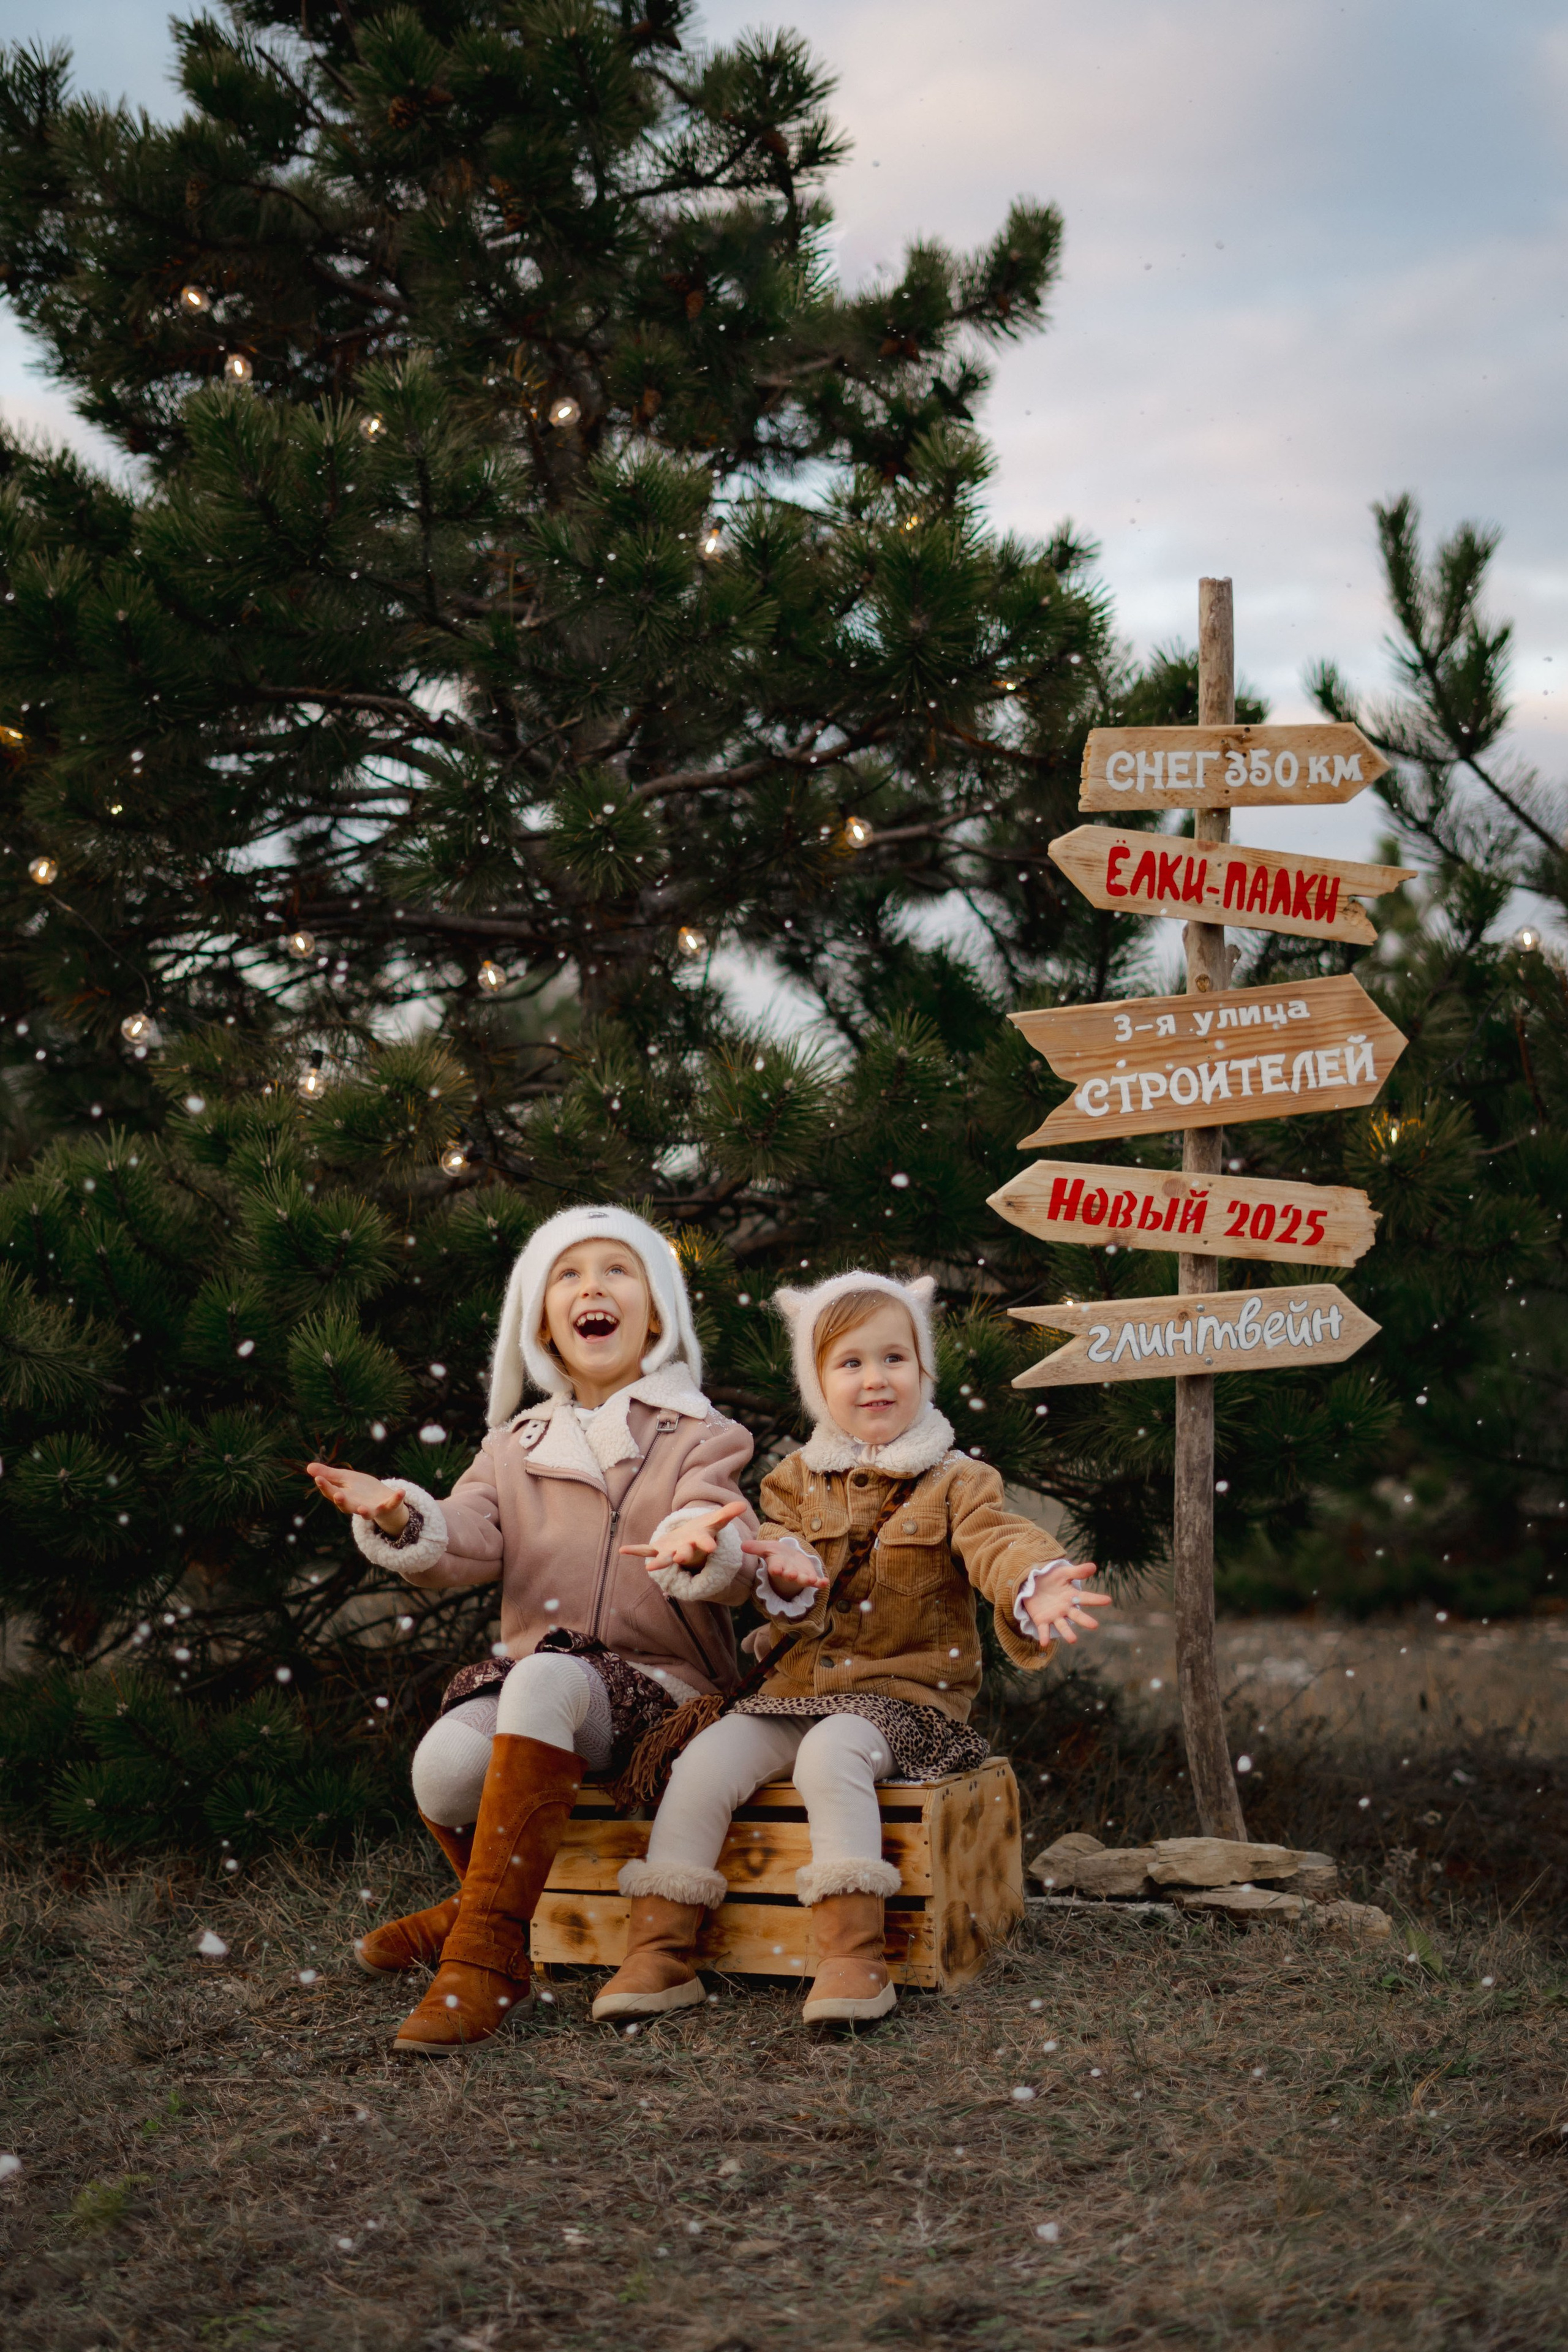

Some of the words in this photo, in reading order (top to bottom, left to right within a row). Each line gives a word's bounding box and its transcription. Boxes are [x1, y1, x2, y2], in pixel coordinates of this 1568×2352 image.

[1106, 750, 1220, 793] СНЕГ
[1225, 748, 1298, 788] 350
[1106, 839, 1340, 924] ЁЛКИ-ПАЛКИ
[1113, 1014, 1176, 1042] 3-я
[1193, 1000, 1310, 1036] улица
[1081, 1035, 1378, 1117] СТРОИТЕЛЕЙ
[1223, 1200, 1327, 1246] 2025
[1087, 1296, 1343, 1363] глинтвейн
